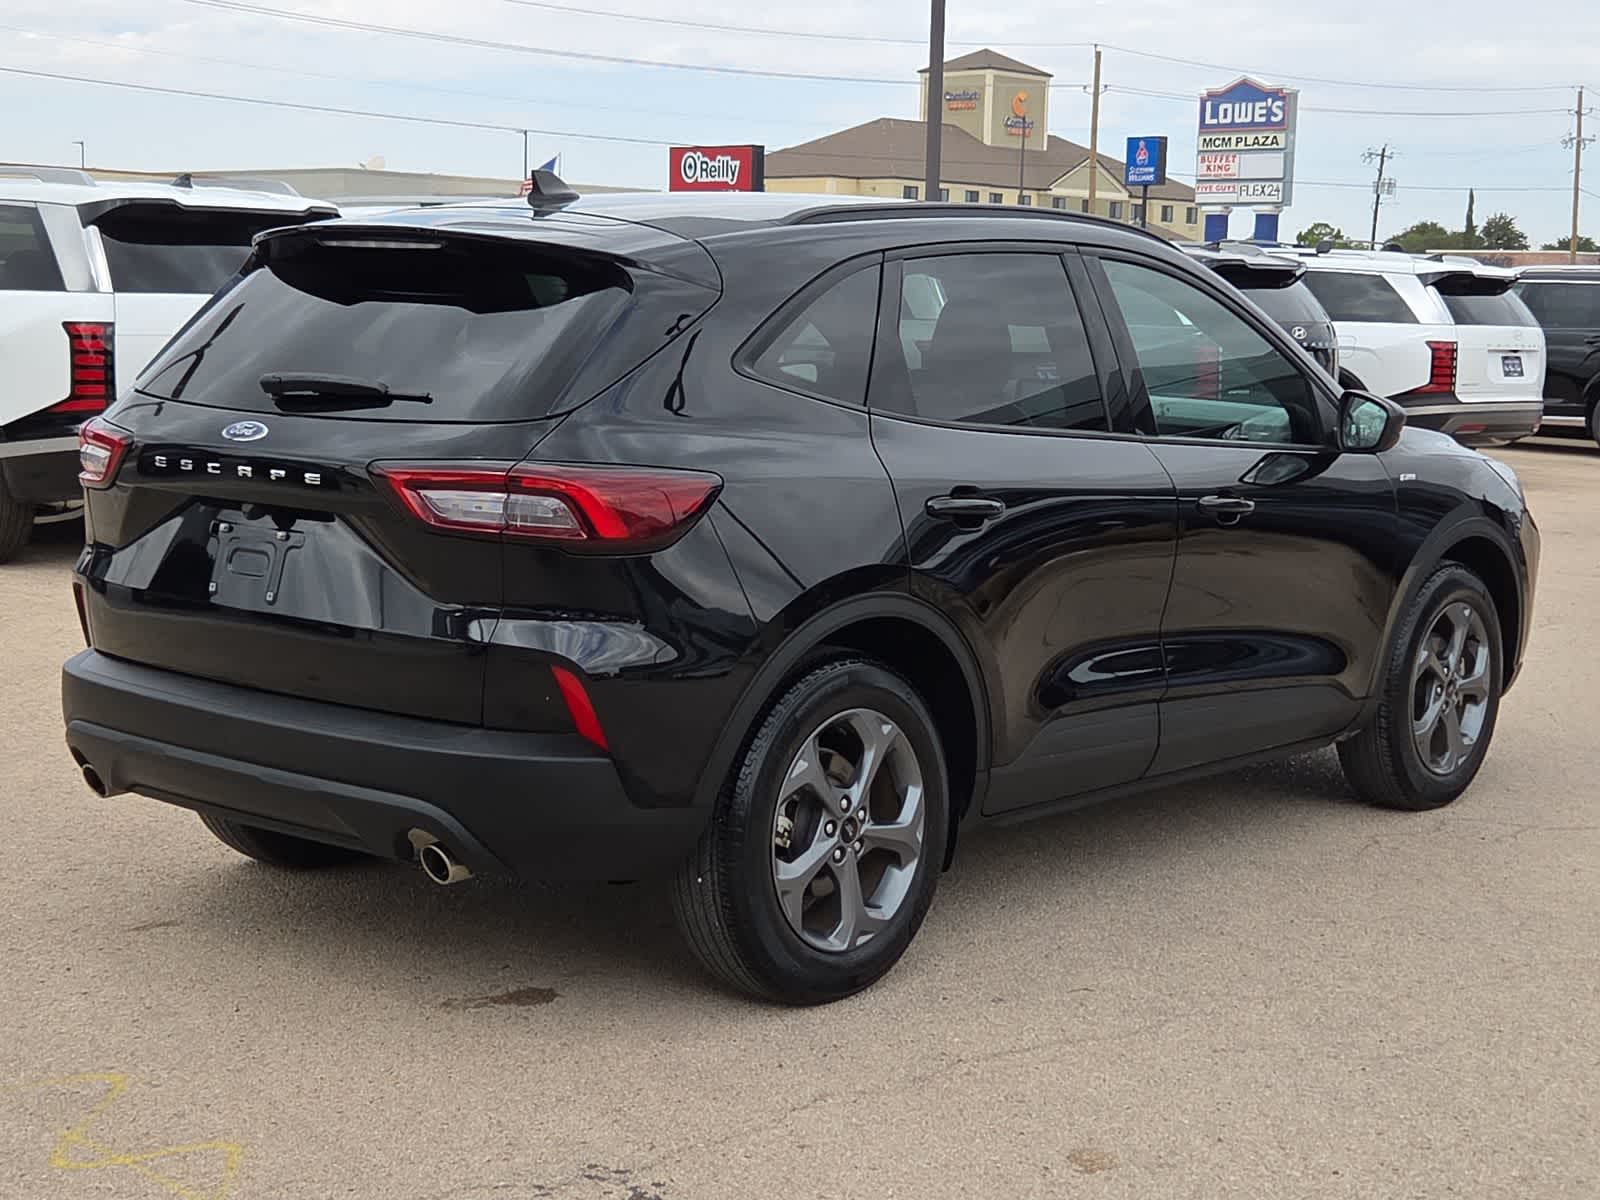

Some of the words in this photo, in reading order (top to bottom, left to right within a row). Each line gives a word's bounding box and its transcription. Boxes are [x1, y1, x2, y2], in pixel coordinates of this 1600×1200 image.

[1204, 98, 1284, 125] LOWE'S
[1202, 137, 1232, 149] MCM
[1235, 135, 1280, 148] PLAZA
[1200, 154, 1236, 164] BUFFET
[681, 153, 739, 184] O'Reilly
[1206, 164, 1231, 172] KING
[1240, 183, 1281, 200] FLEX24
[154, 455, 321, 485] ESCAPE
